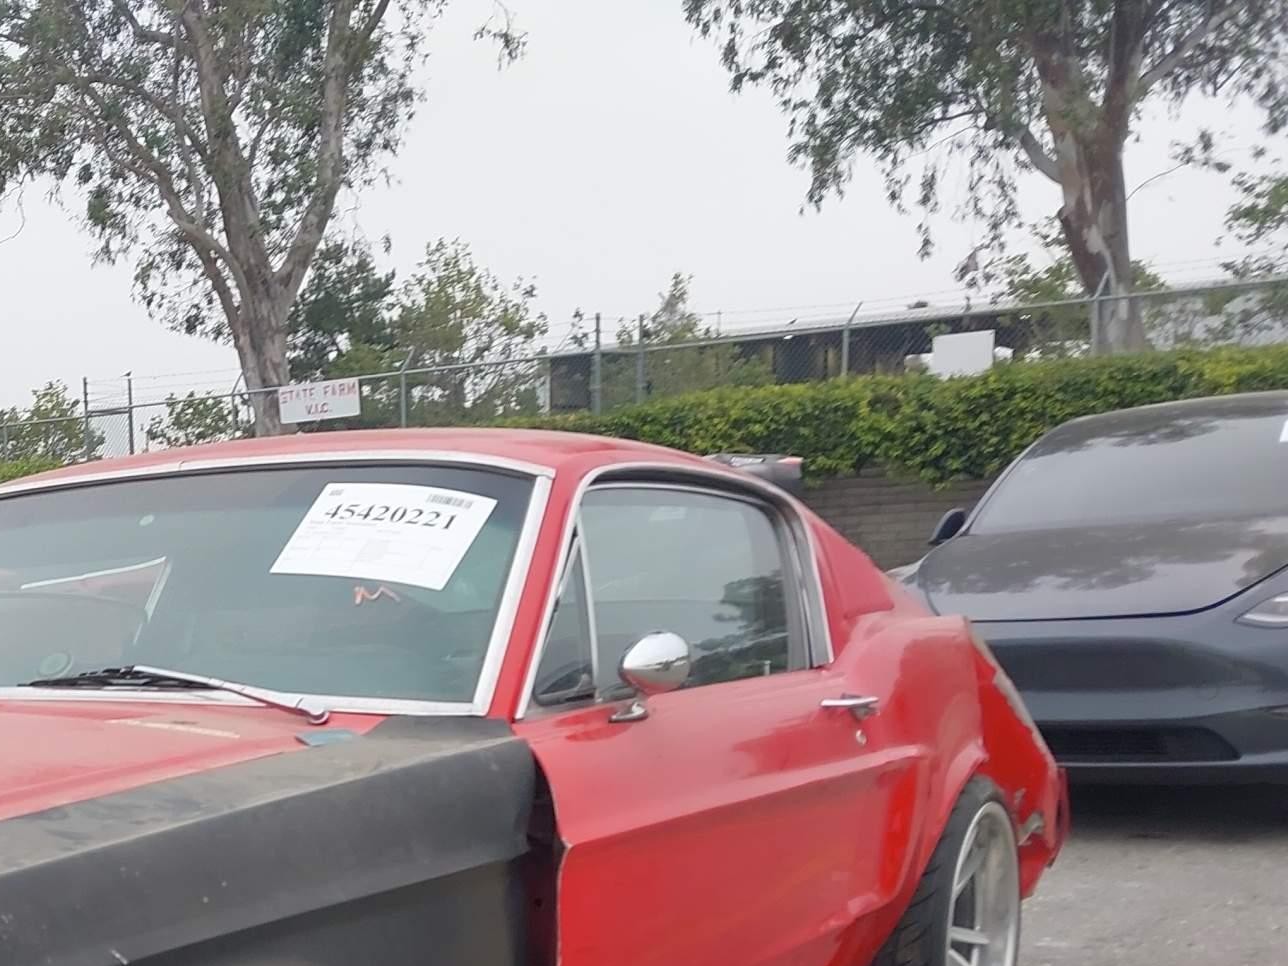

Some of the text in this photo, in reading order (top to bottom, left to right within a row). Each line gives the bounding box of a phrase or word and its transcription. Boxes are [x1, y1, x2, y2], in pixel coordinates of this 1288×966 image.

[280, 381, 357, 405] STATE FARM
[324, 502, 458, 531] 45420221
